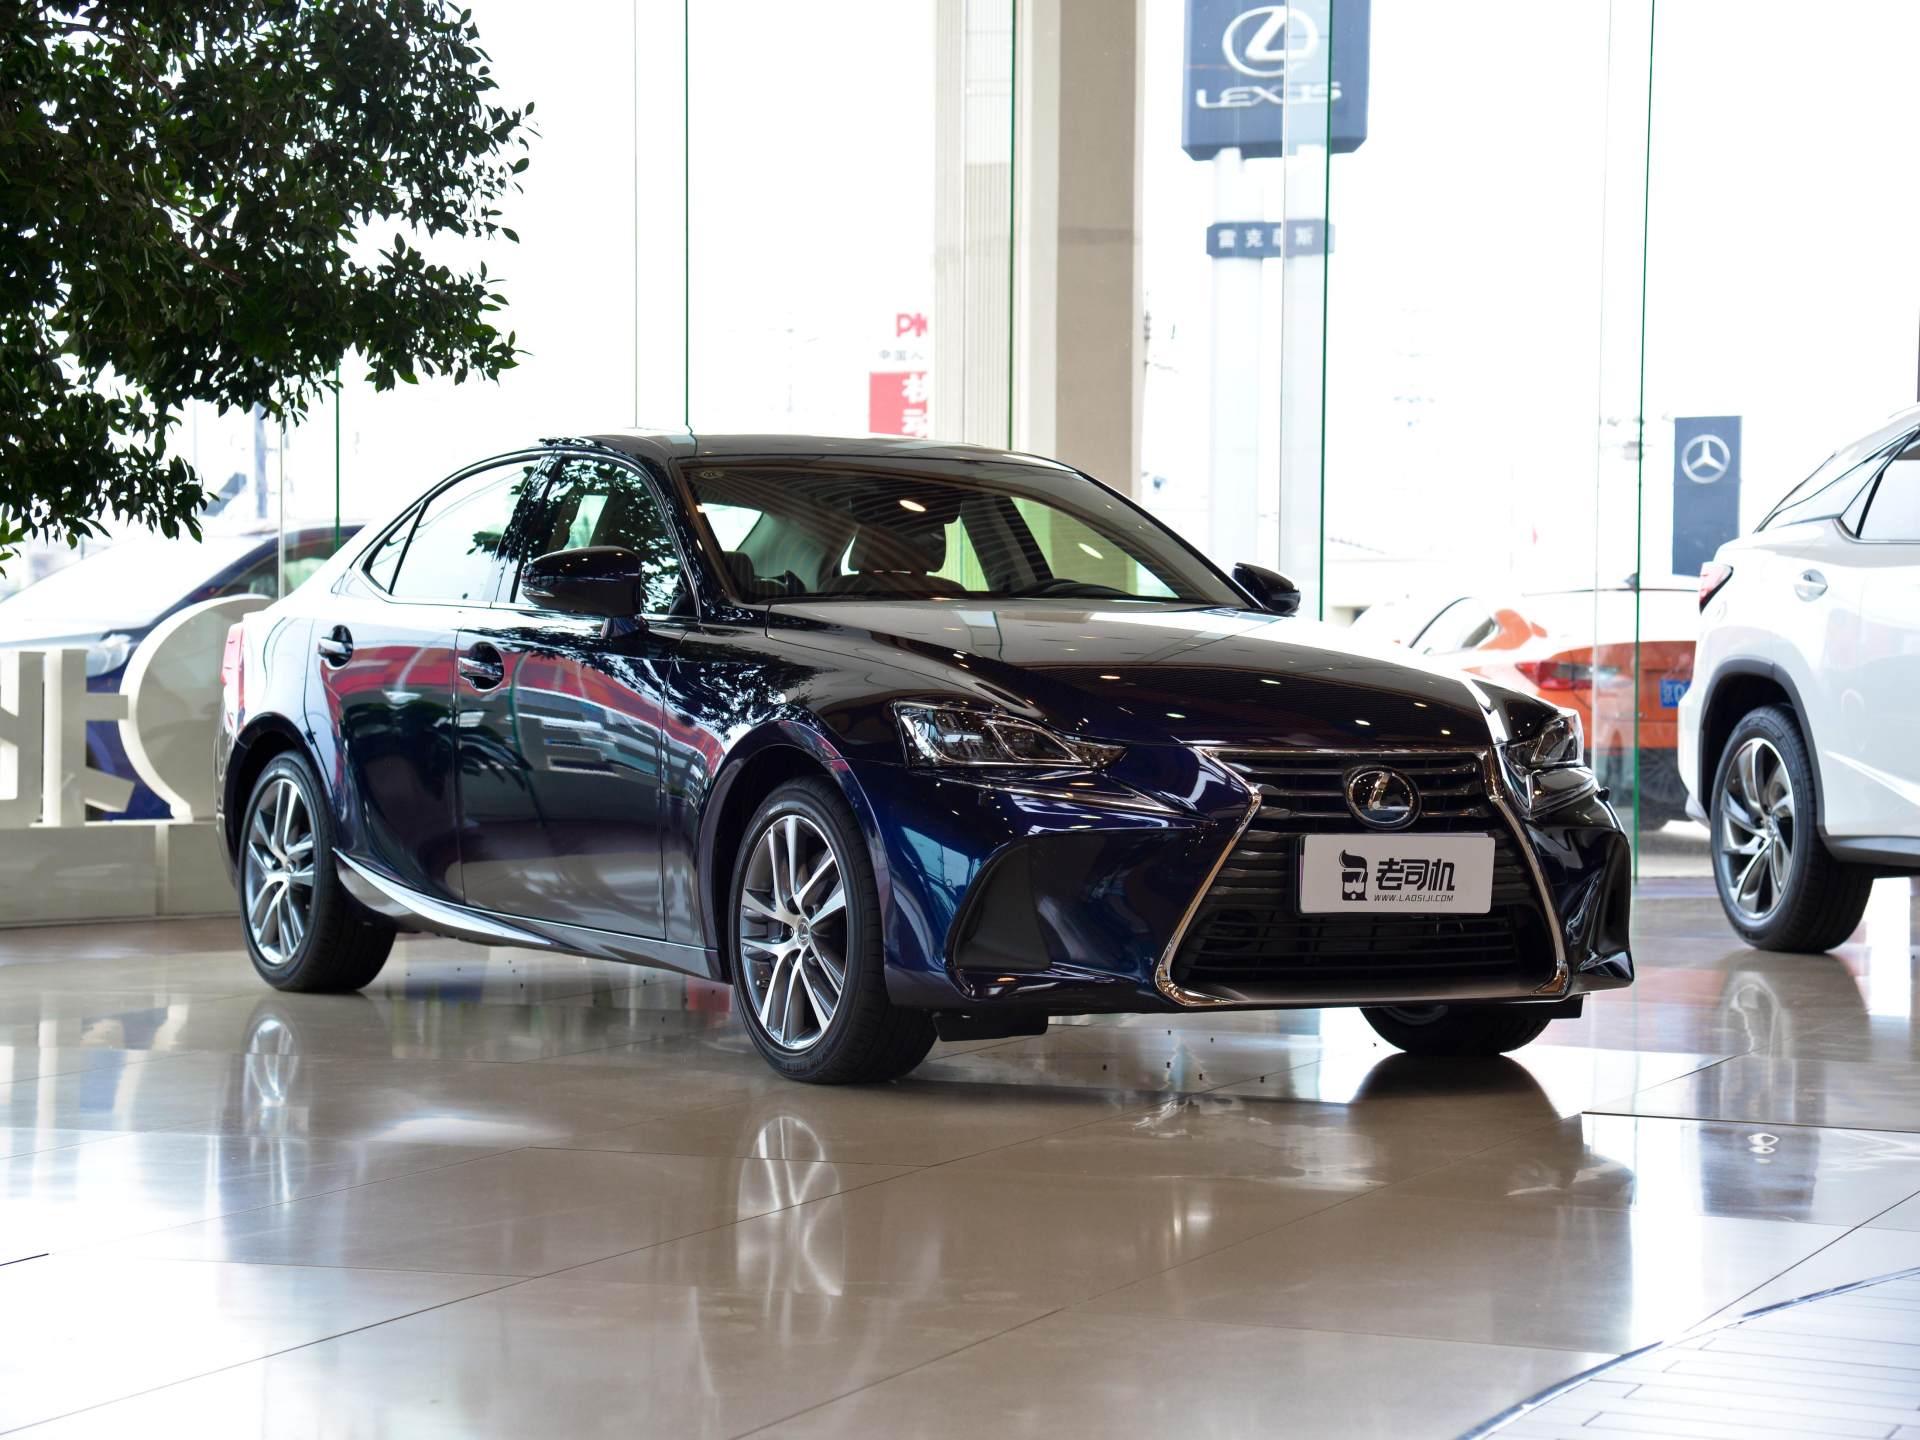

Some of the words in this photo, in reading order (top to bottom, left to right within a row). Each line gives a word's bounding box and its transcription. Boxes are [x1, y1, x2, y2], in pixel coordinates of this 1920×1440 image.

[1376, 857, 1456, 891] 老司机
[1374, 894, 1454, 902] WWW.LAOSIJI.COM
